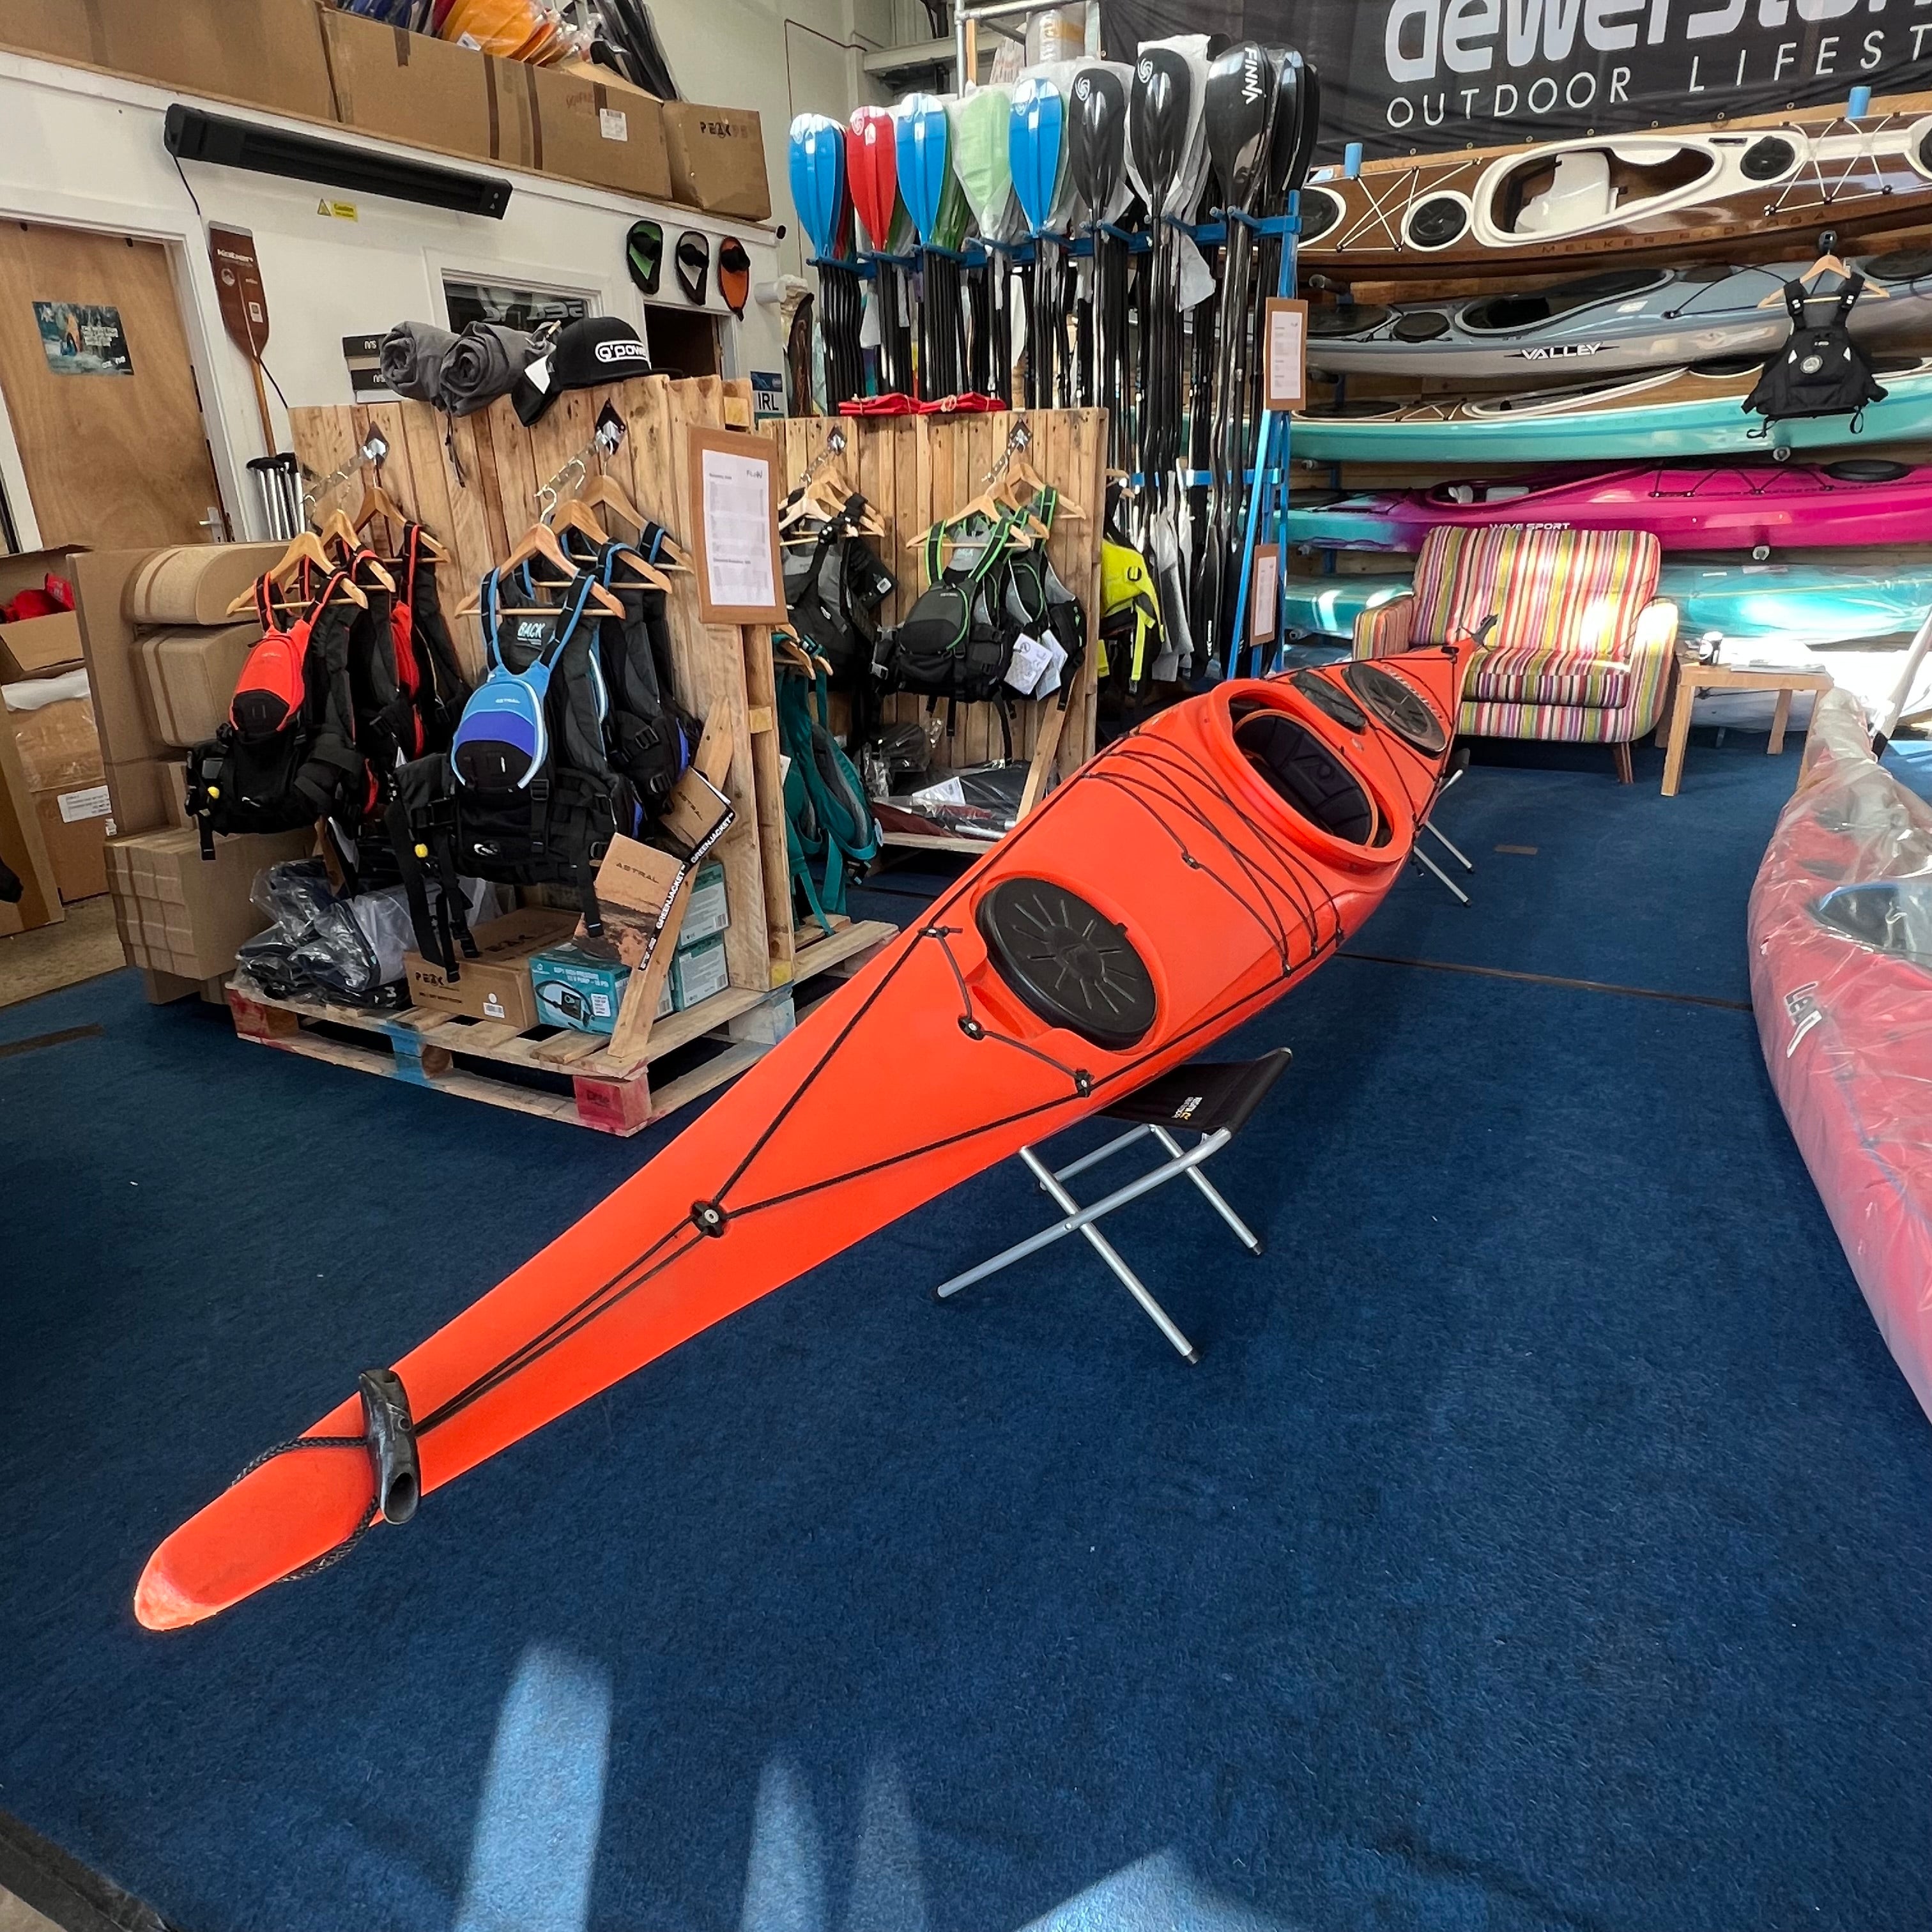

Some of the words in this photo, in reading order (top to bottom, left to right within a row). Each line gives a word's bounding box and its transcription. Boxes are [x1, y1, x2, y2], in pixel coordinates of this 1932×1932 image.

[1386, 66, 1630, 128] OUTDOOR
[1522, 341, 1603, 360] VALLEY
[758, 391, 779, 411] IRL
[1526, 522, 1570, 530] SPORT
[518, 622, 546, 638] BACK
[677, 791, 703, 822] ASTRAL
[616, 862, 659, 884] ASTRAL
